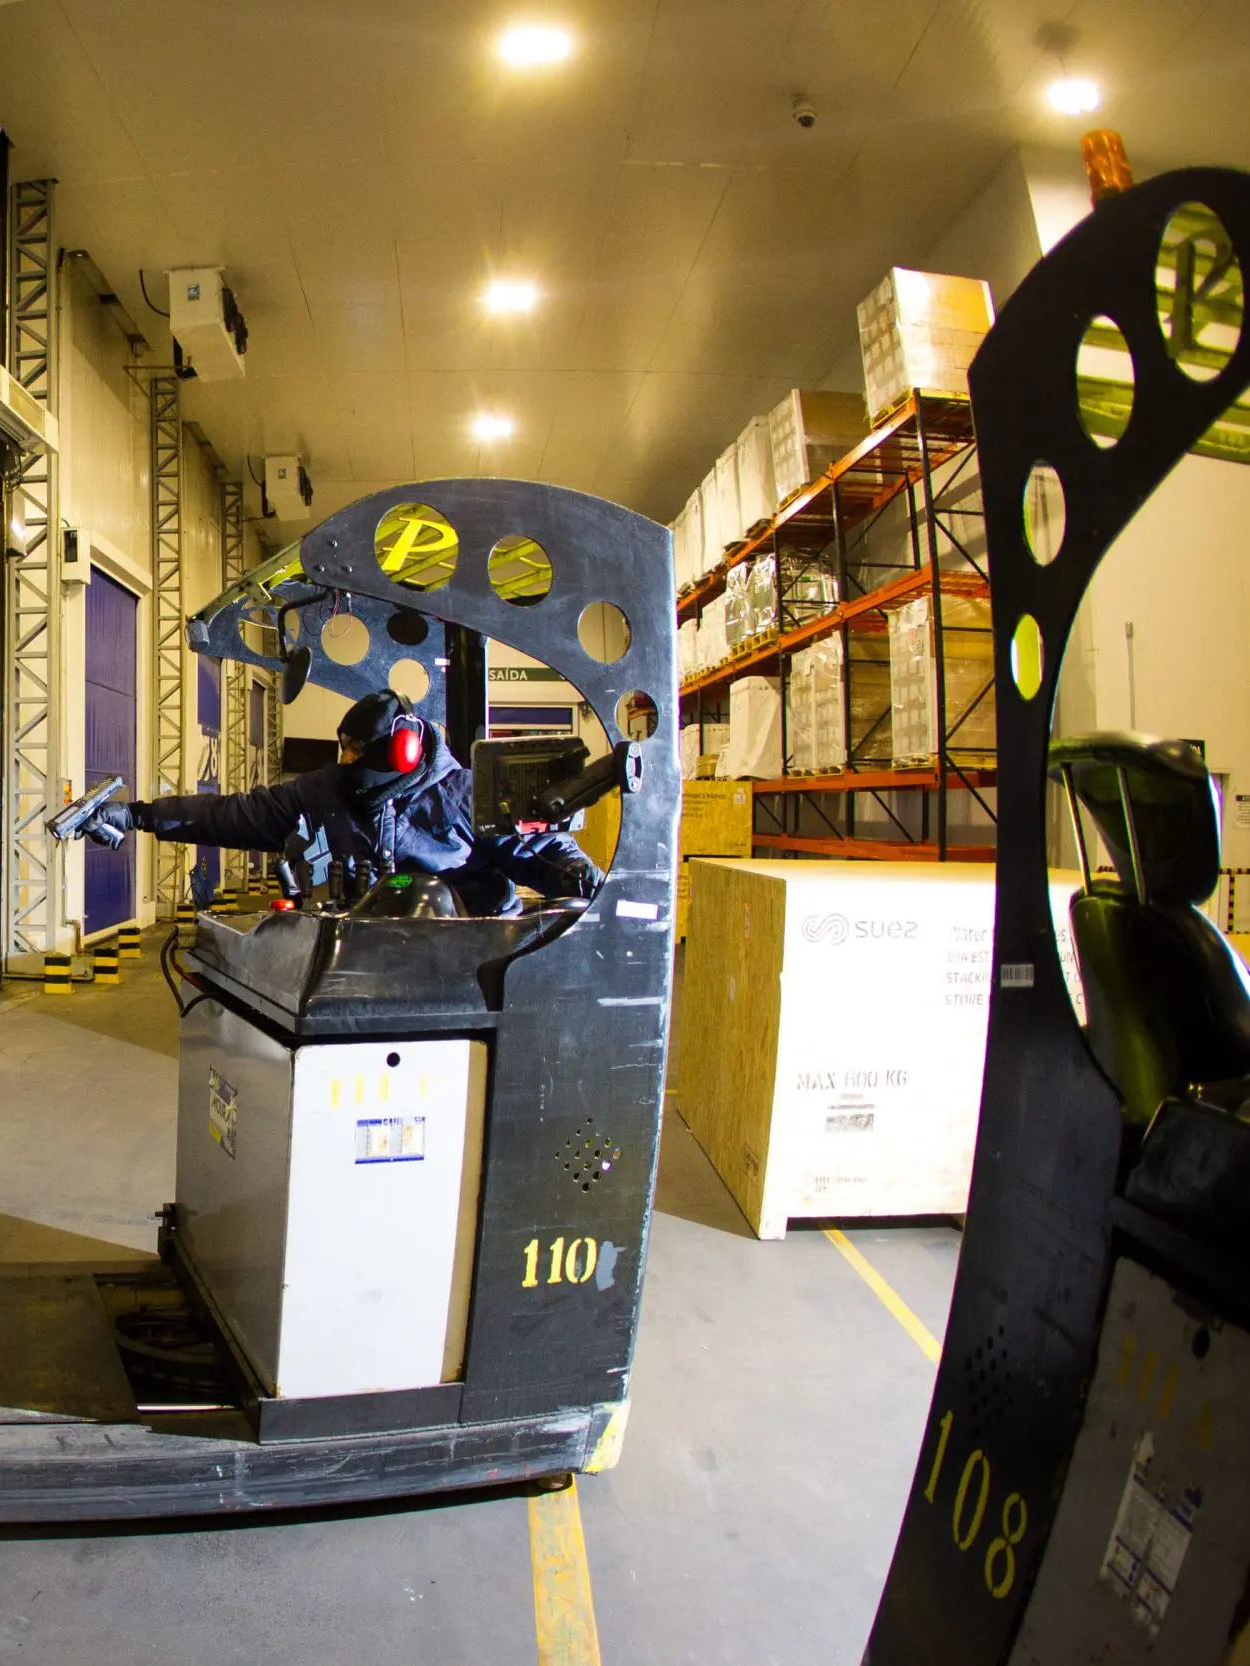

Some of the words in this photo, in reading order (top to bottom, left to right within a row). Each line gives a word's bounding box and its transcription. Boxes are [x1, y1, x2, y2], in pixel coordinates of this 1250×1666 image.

[489, 667, 528, 681] SAÍDA
[854, 920, 919, 939] suez
[797, 1072, 836, 1090] MAX
[886, 1069, 907, 1087] KG
[522, 1236, 598, 1288] 110
[924, 1409, 1028, 1599] 108
